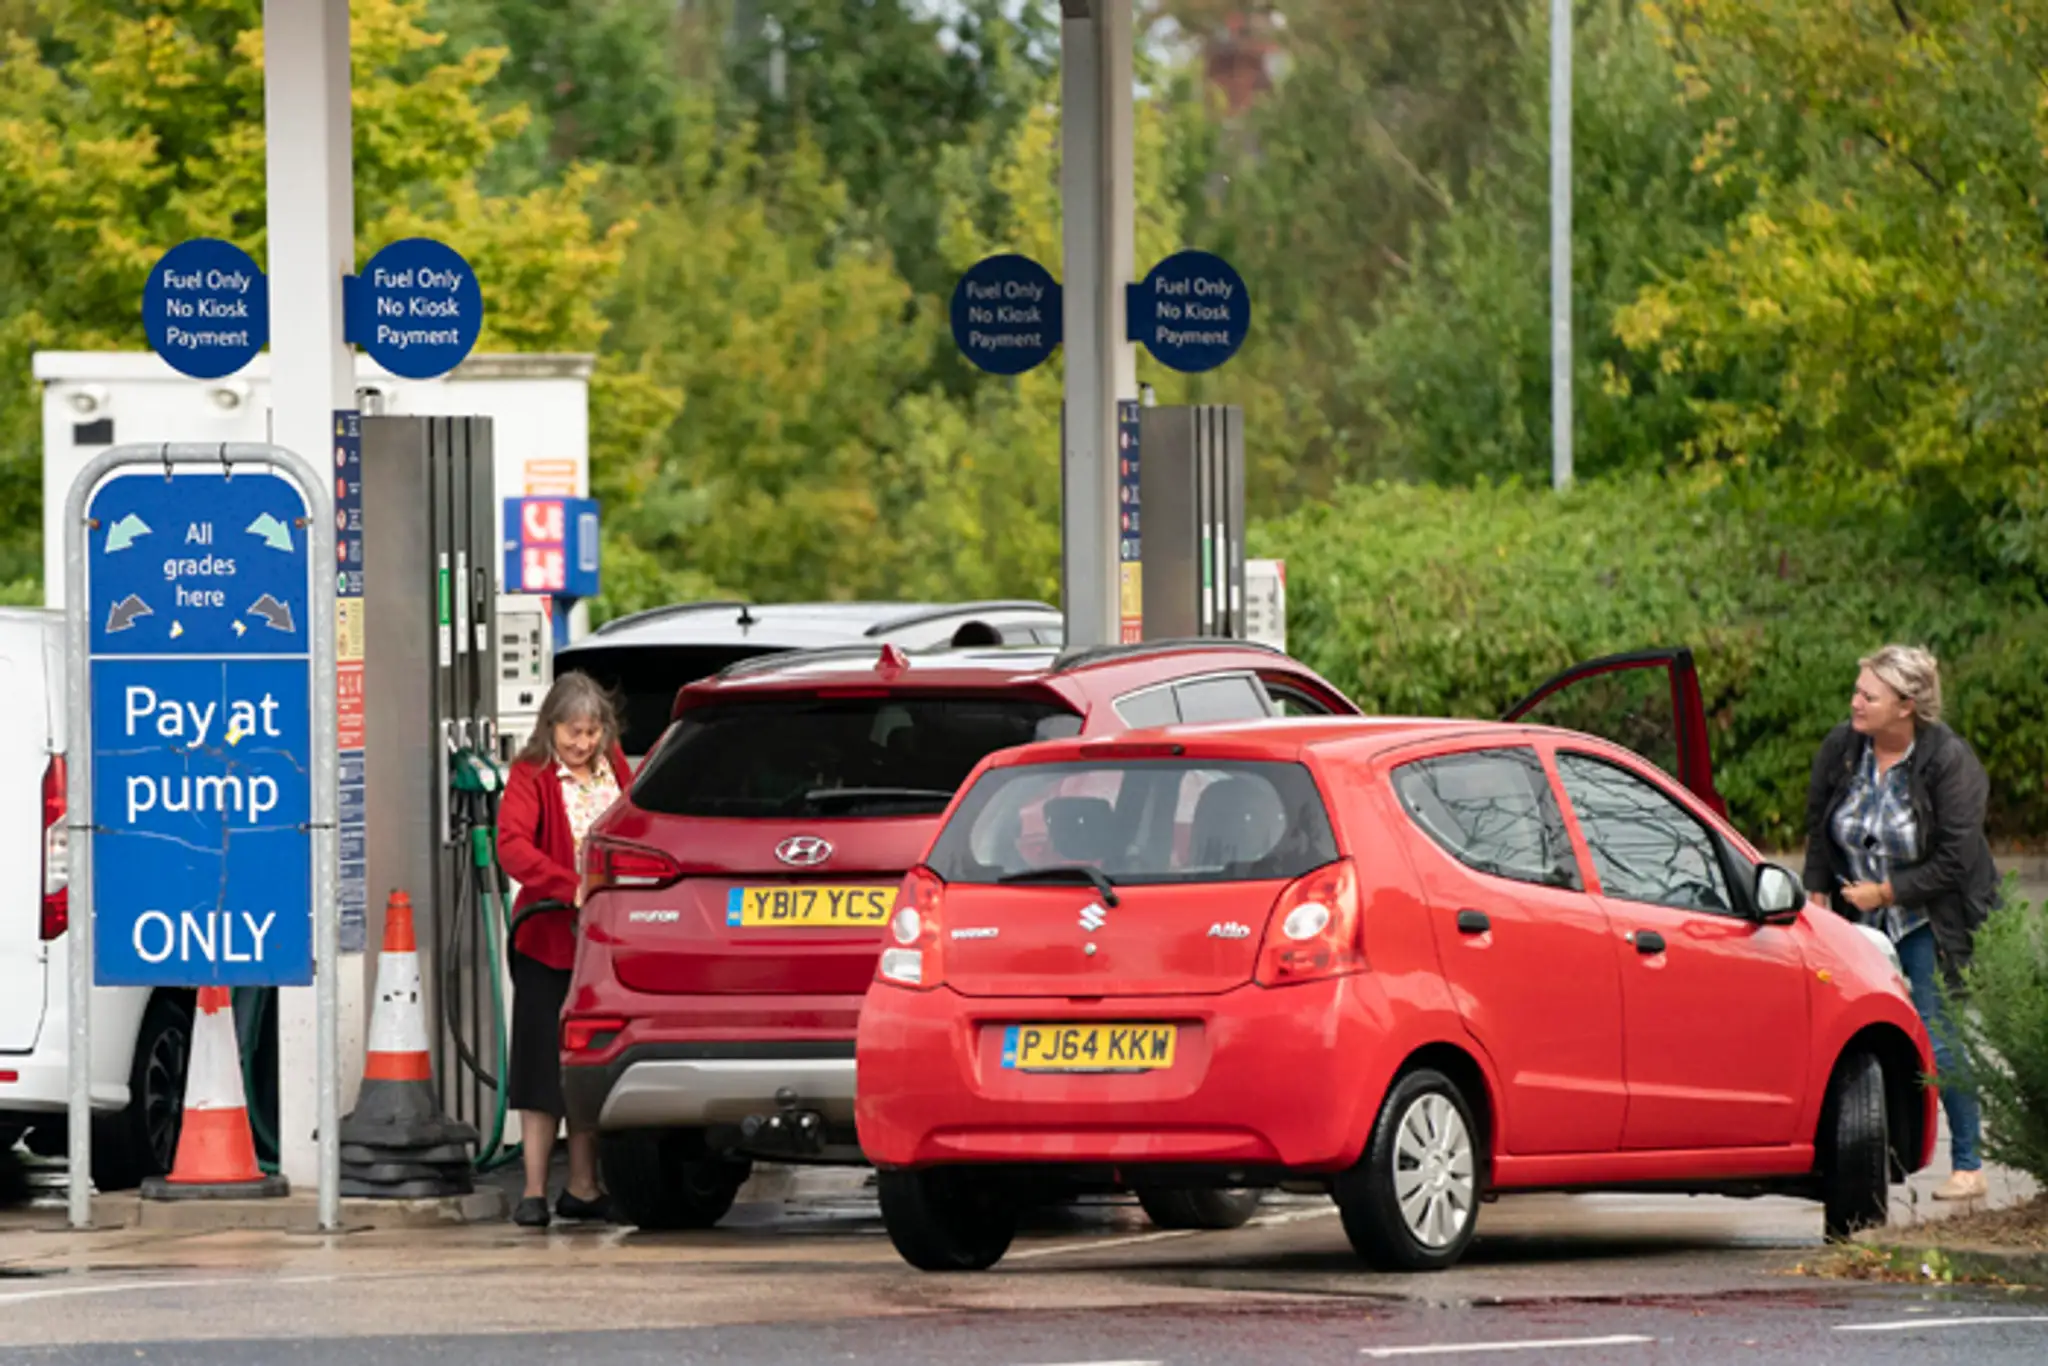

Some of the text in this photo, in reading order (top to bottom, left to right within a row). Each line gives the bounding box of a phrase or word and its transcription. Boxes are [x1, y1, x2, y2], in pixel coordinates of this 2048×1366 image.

[163, 270, 250, 292] Fuel Only
[374, 268, 462, 291] Fuel Only
[1155, 277, 1233, 299] Fuel Only
[966, 281, 1043, 302] Fuel Only
[167, 298, 247, 317] No Kiosk
[377, 297, 459, 316] No Kiosk
[969, 306, 1041, 323] No Kiosk
[1156, 302, 1231, 321] No Kiosk
[166, 328, 248, 348] Payment
[377, 327, 459, 347] Payment
[969, 331, 1042, 349] Payment
[1156, 326, 1230, 346] Payment
[185, 522, 212, 545] All
[163, 554, 236, 581] grades
[176, 585, 225, 607] here
[125, 686, 216, 748] Pay
[226, 692, 281, 736] at
[127, 775, 279, 823] pump
[754, 890, 886, 920] YB17 YCS
[132, 910, 276, 963] ONLY
[1021, 1029, 1170, 1061] PJ64 KKW
